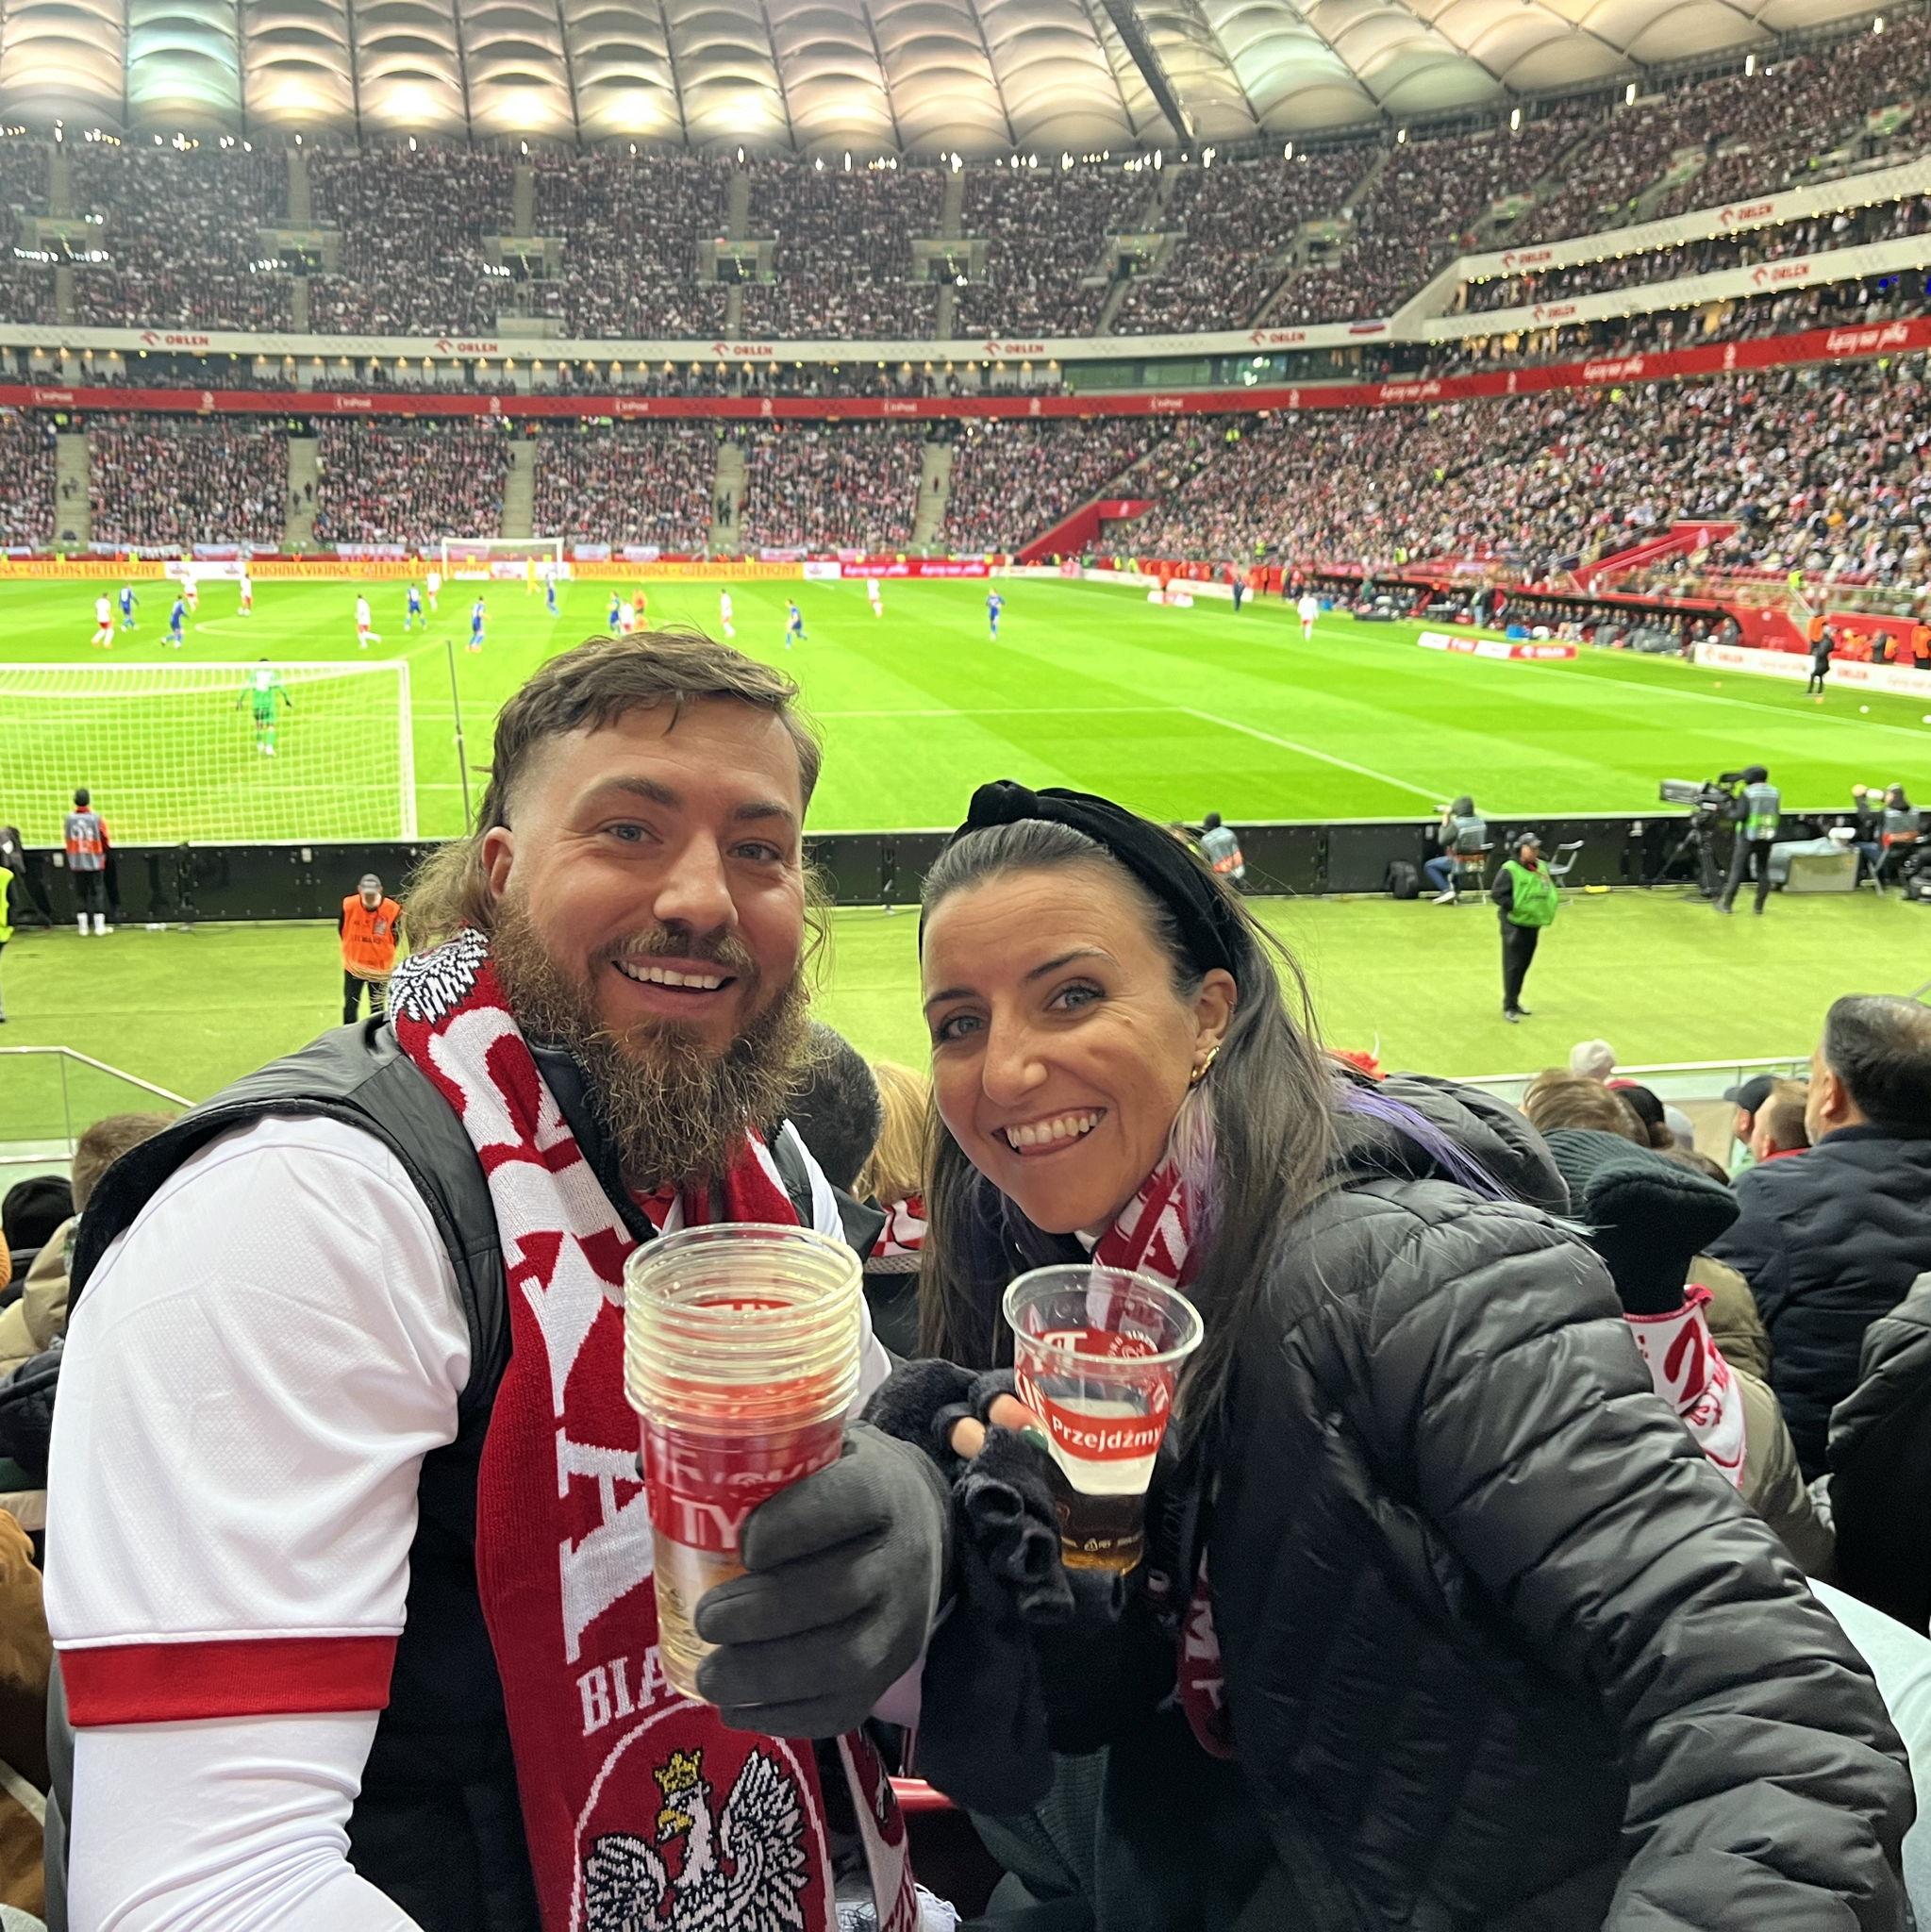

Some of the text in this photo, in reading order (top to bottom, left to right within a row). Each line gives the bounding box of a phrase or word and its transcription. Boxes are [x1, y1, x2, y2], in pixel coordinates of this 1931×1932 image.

[165, 334, 208, 346] ORLEN
[458, 342, 498, 353] ORLEN
[1006, 343, 1044, 354] ORLEN
[576, 1644, 677, 1737] BIA
